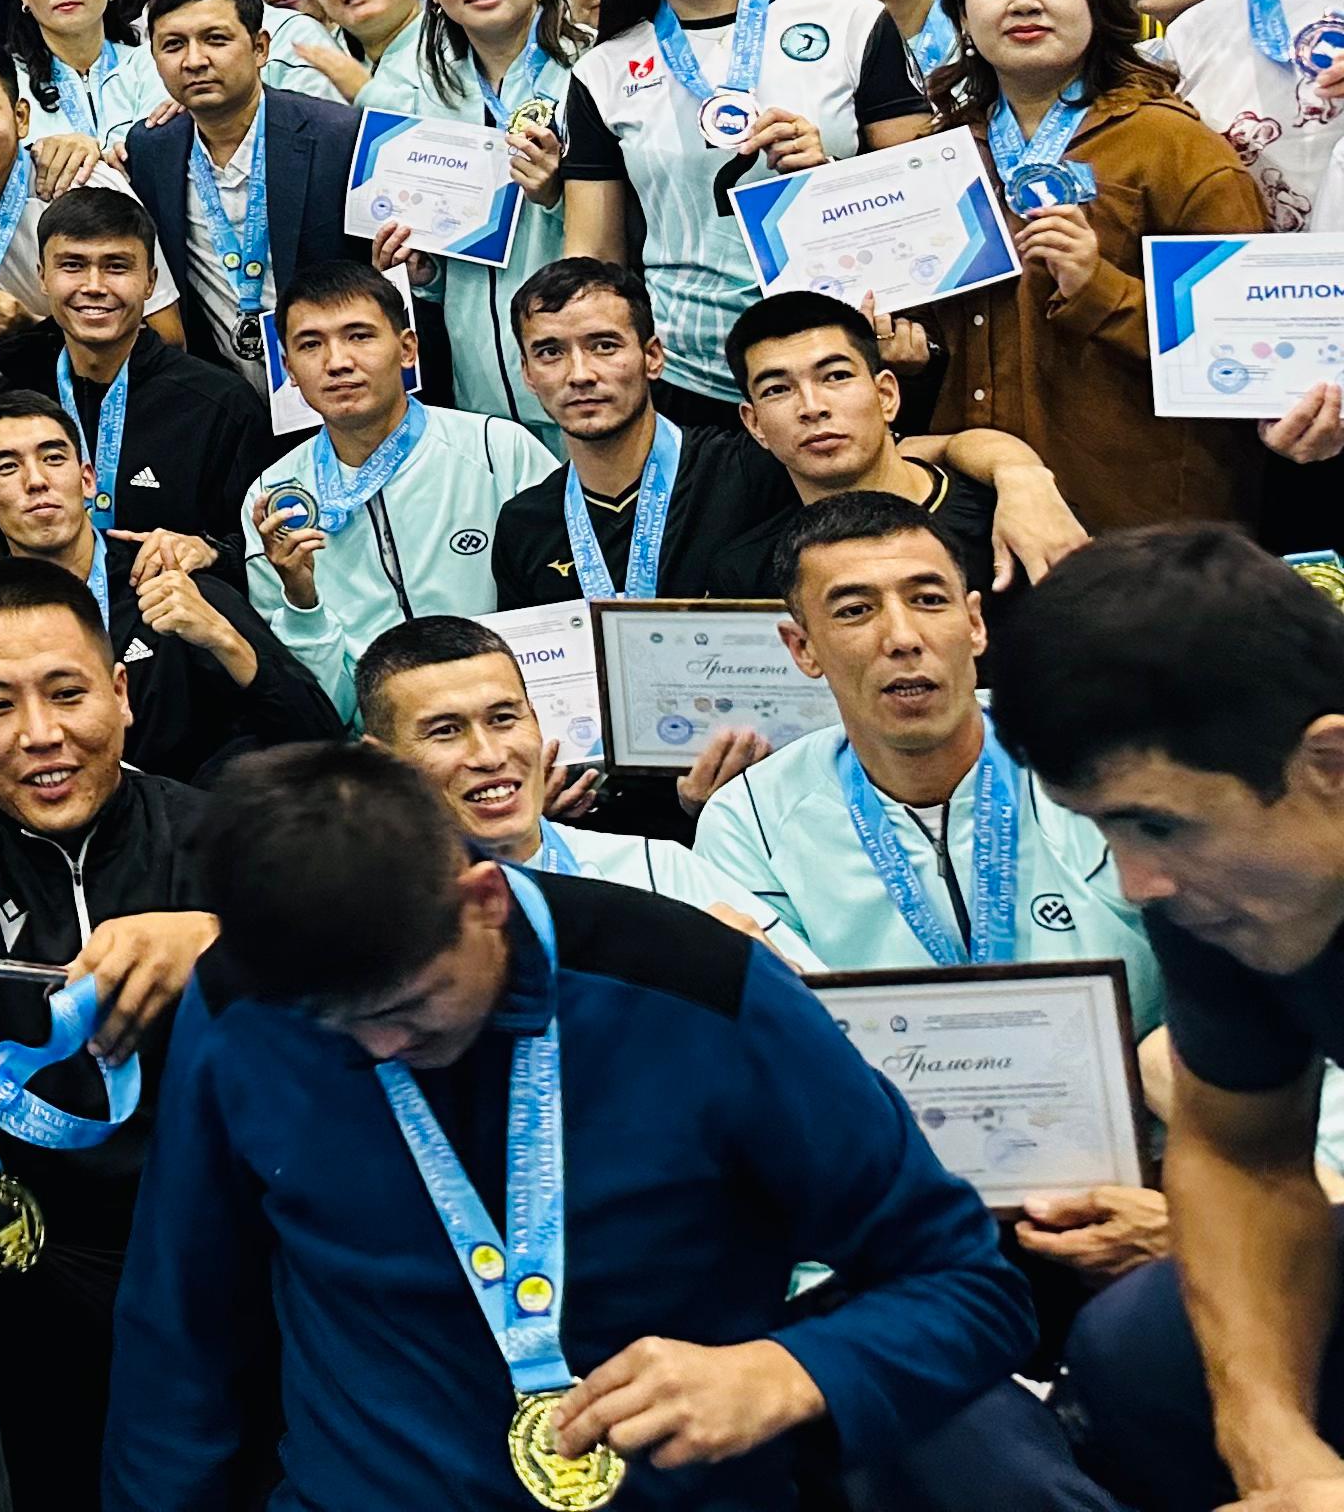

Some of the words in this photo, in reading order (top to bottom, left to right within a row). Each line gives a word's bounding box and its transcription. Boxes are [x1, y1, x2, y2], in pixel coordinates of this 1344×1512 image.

[407, 152, 468, 171] ДИПЛОМ
[822, 191, 906, 224] ДИПЛОМ
[1246, 285, 1344, 301] ДИПЛОМ
[686, 654, 788, 680] Грамота
[882, 1045, 1013, 1082] Грамота
